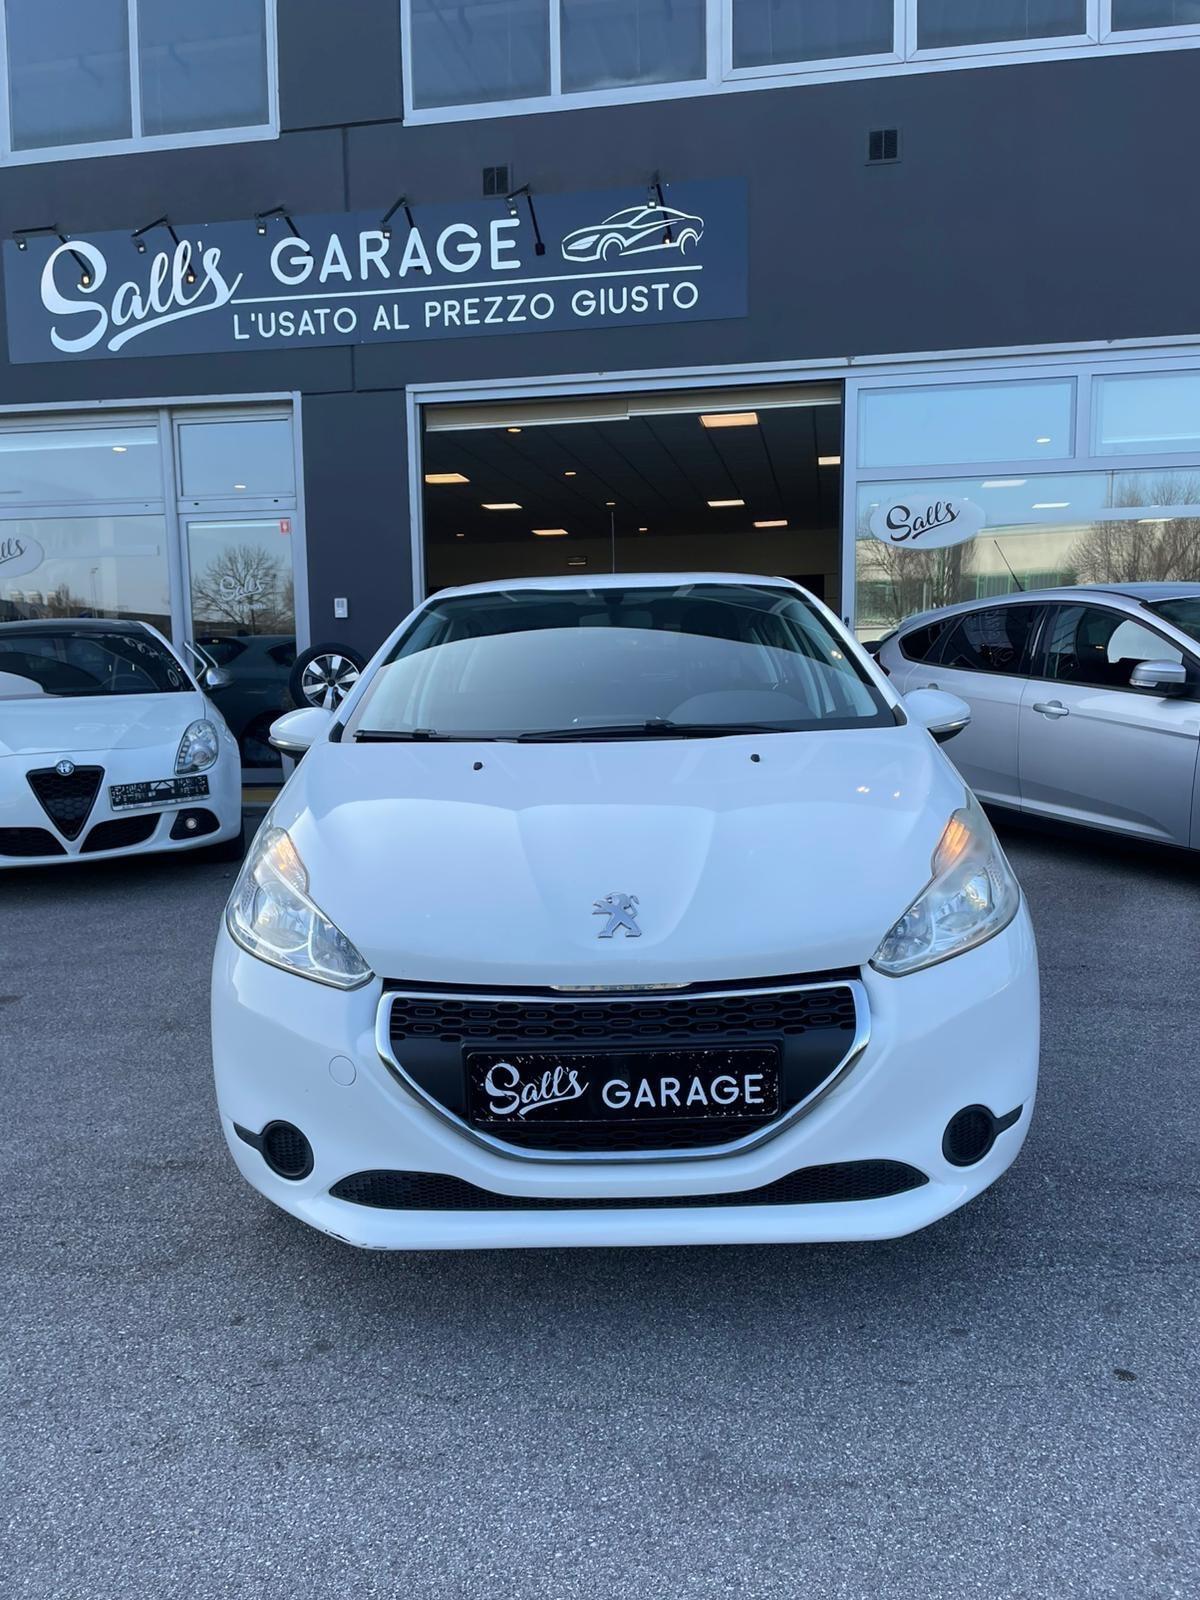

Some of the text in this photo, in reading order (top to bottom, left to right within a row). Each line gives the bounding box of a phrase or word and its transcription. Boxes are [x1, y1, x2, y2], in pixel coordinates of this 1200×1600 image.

[41, 218, 521, 352] Sall's GARAGE
[233, 281, 699, 340] L'USATO AL PREZZO GIUSTO
[886, 501, 960, 541] Sall's
[0, 537, 27, 564] ll's
[484, 1062, 765, 1116] Sall's GARAGE
